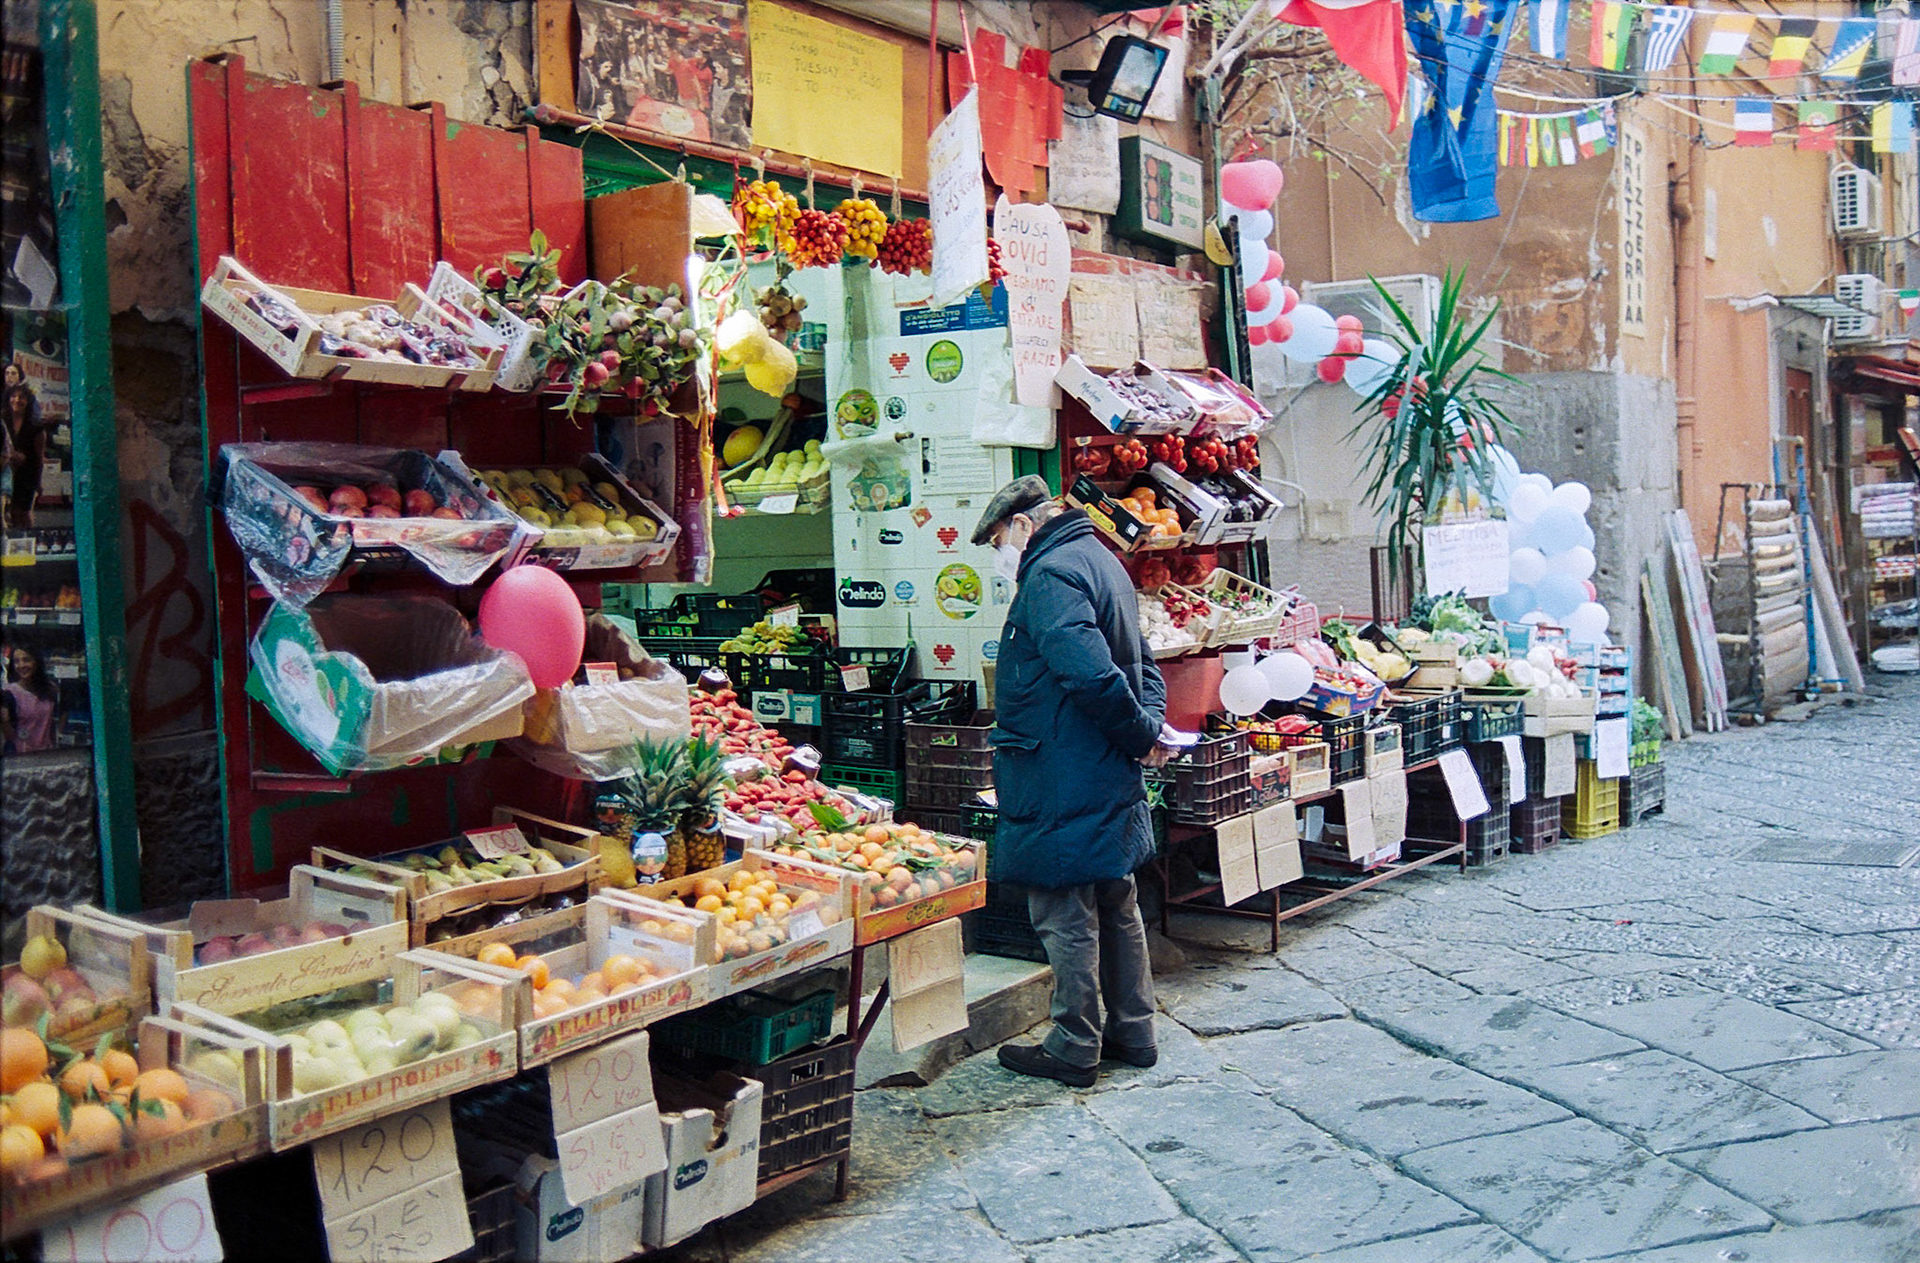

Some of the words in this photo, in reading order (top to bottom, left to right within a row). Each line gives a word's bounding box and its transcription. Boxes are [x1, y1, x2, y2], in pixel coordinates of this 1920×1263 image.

[1624, 133, 1634, 324] TRATTORIA
[1635, 141, 1643, 324] PIZZERIA
[676, 506, 687, 561] PIAANA
[839, 585, 885, 601] Melinda
[390, 1055, 466, 1100] POLISE
